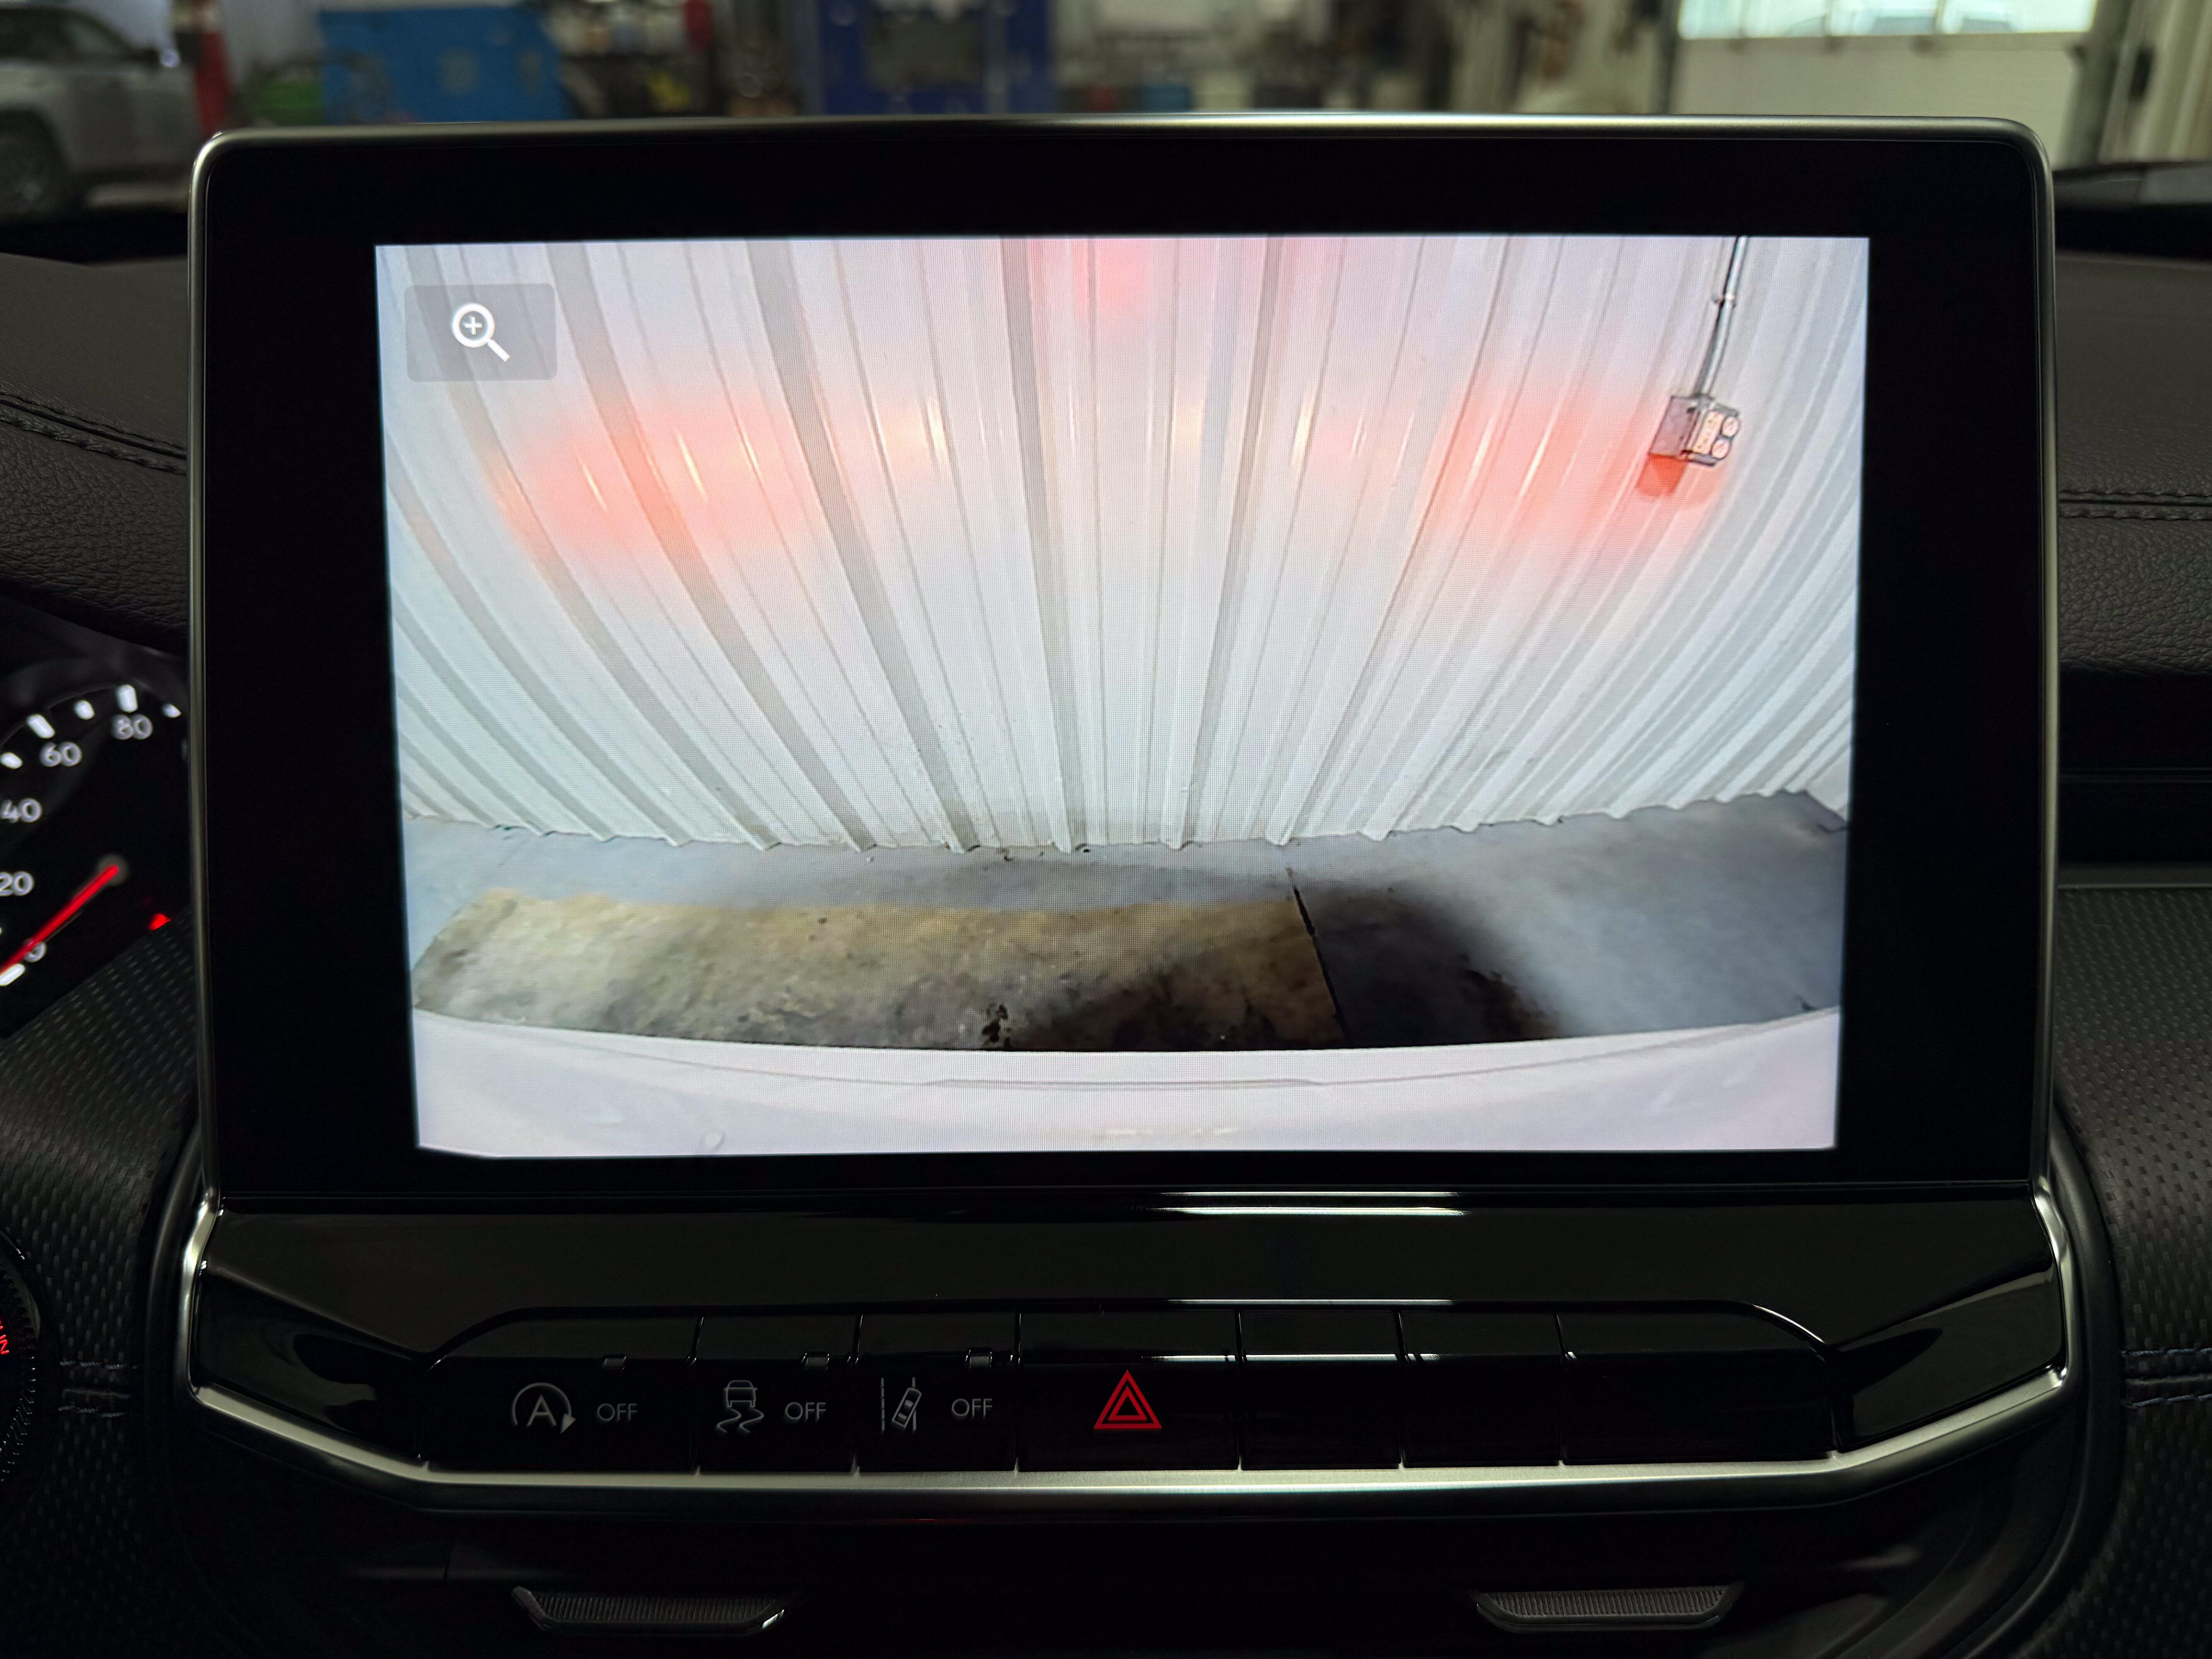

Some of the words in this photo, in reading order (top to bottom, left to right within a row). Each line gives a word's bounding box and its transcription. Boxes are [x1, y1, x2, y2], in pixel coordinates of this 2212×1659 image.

[111, 714, 153, 740] 80
[40, 742, 82, 767] 60
[0, 798, 42, 823] 40
[0, 871, 34, 896] 20
[527, 1395, 557, 1427] A
[597, 1403, 637, 1421] OFF
[785, 1401, 826, 1421] OFF
[951, 1398, 992, 1418] OFF
